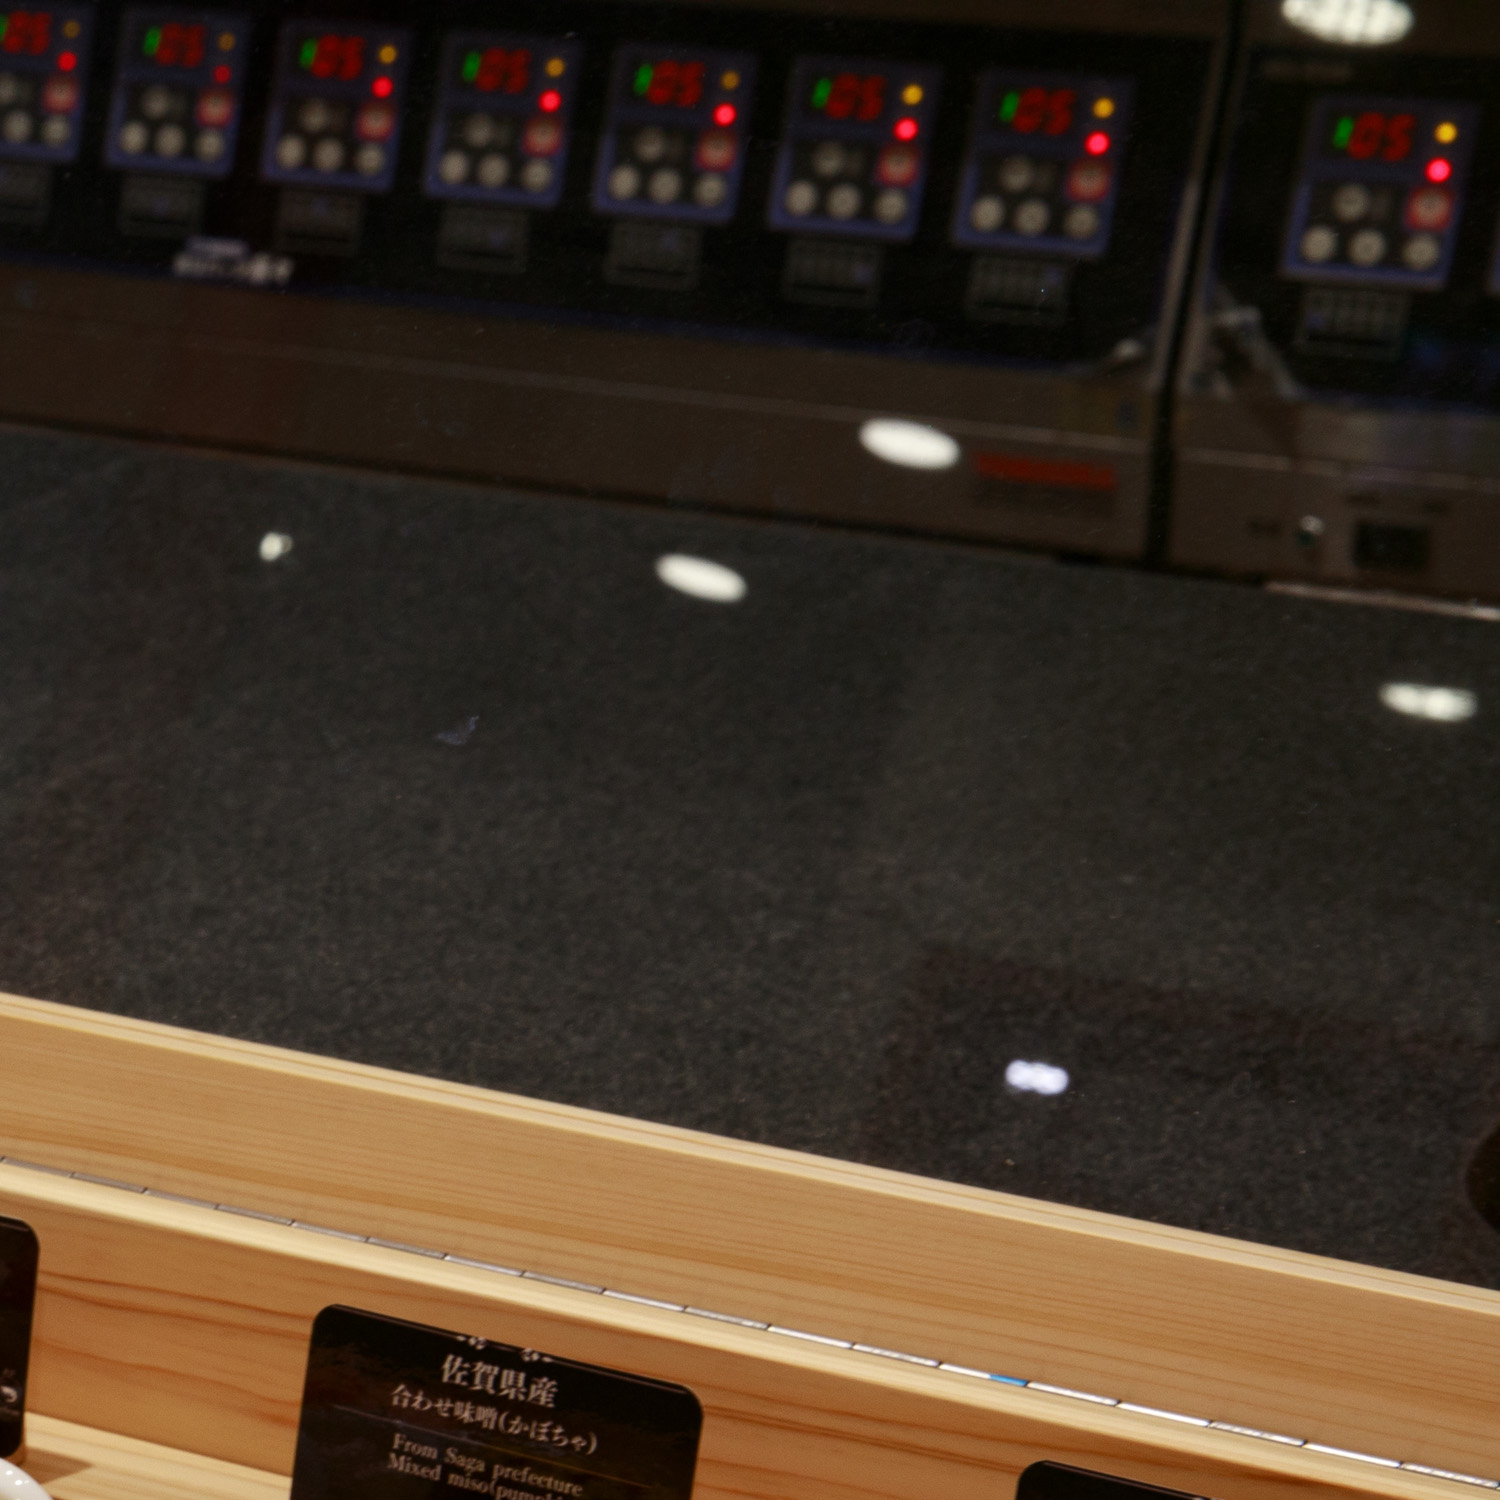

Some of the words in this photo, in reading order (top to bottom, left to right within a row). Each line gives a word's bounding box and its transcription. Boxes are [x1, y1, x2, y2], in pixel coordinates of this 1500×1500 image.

[441, 1354, 559, 1408] 佐賀県産
[391, 1385, 598, 1456] 合わせ味噌(かぼちゃ)
[387, 1452, 441, 1482] Mixed
[392, 1434, 438, 1461] From
[445, 1446, 486, 1475] Saga
[492, 1464, 584, 1497] prefecture
